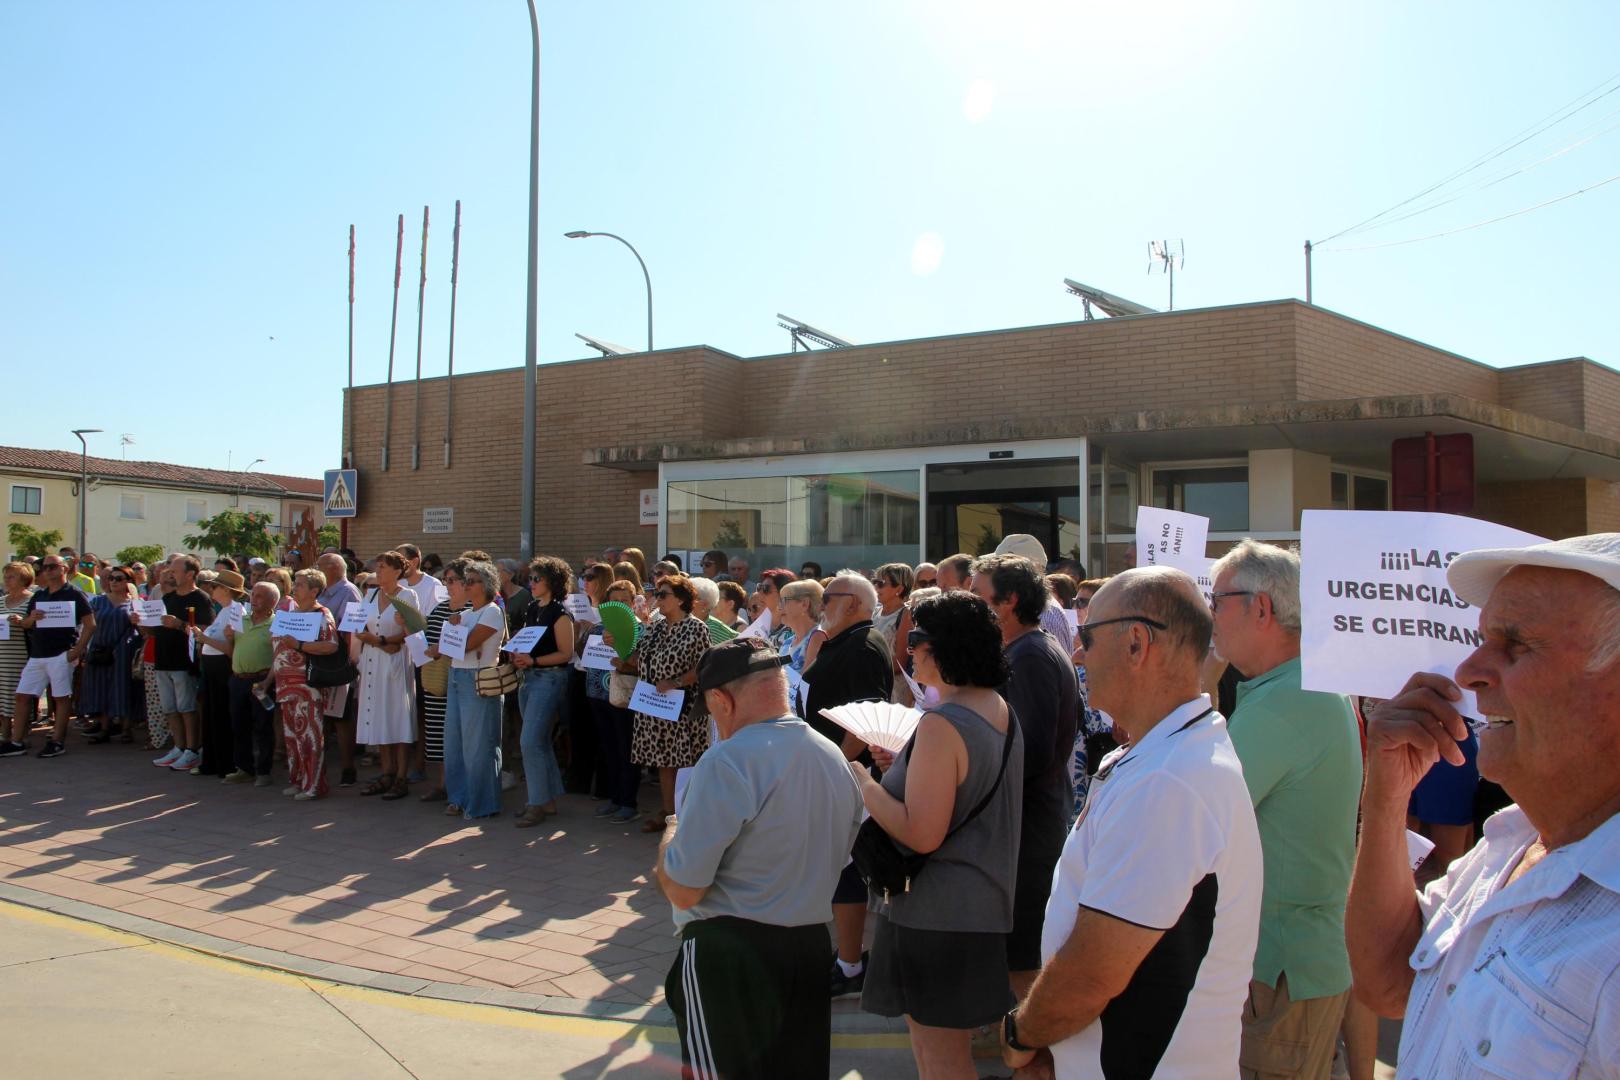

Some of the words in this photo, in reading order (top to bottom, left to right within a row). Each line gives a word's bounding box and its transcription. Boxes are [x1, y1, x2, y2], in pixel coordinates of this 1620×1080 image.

[1162, 523, 1170, 537] NO
[1328, 580, 1470, 609] URGENCIAS
[1334, 614, 1364, 633] SE
[1372, 617, 1484, 648] CIERRAN
